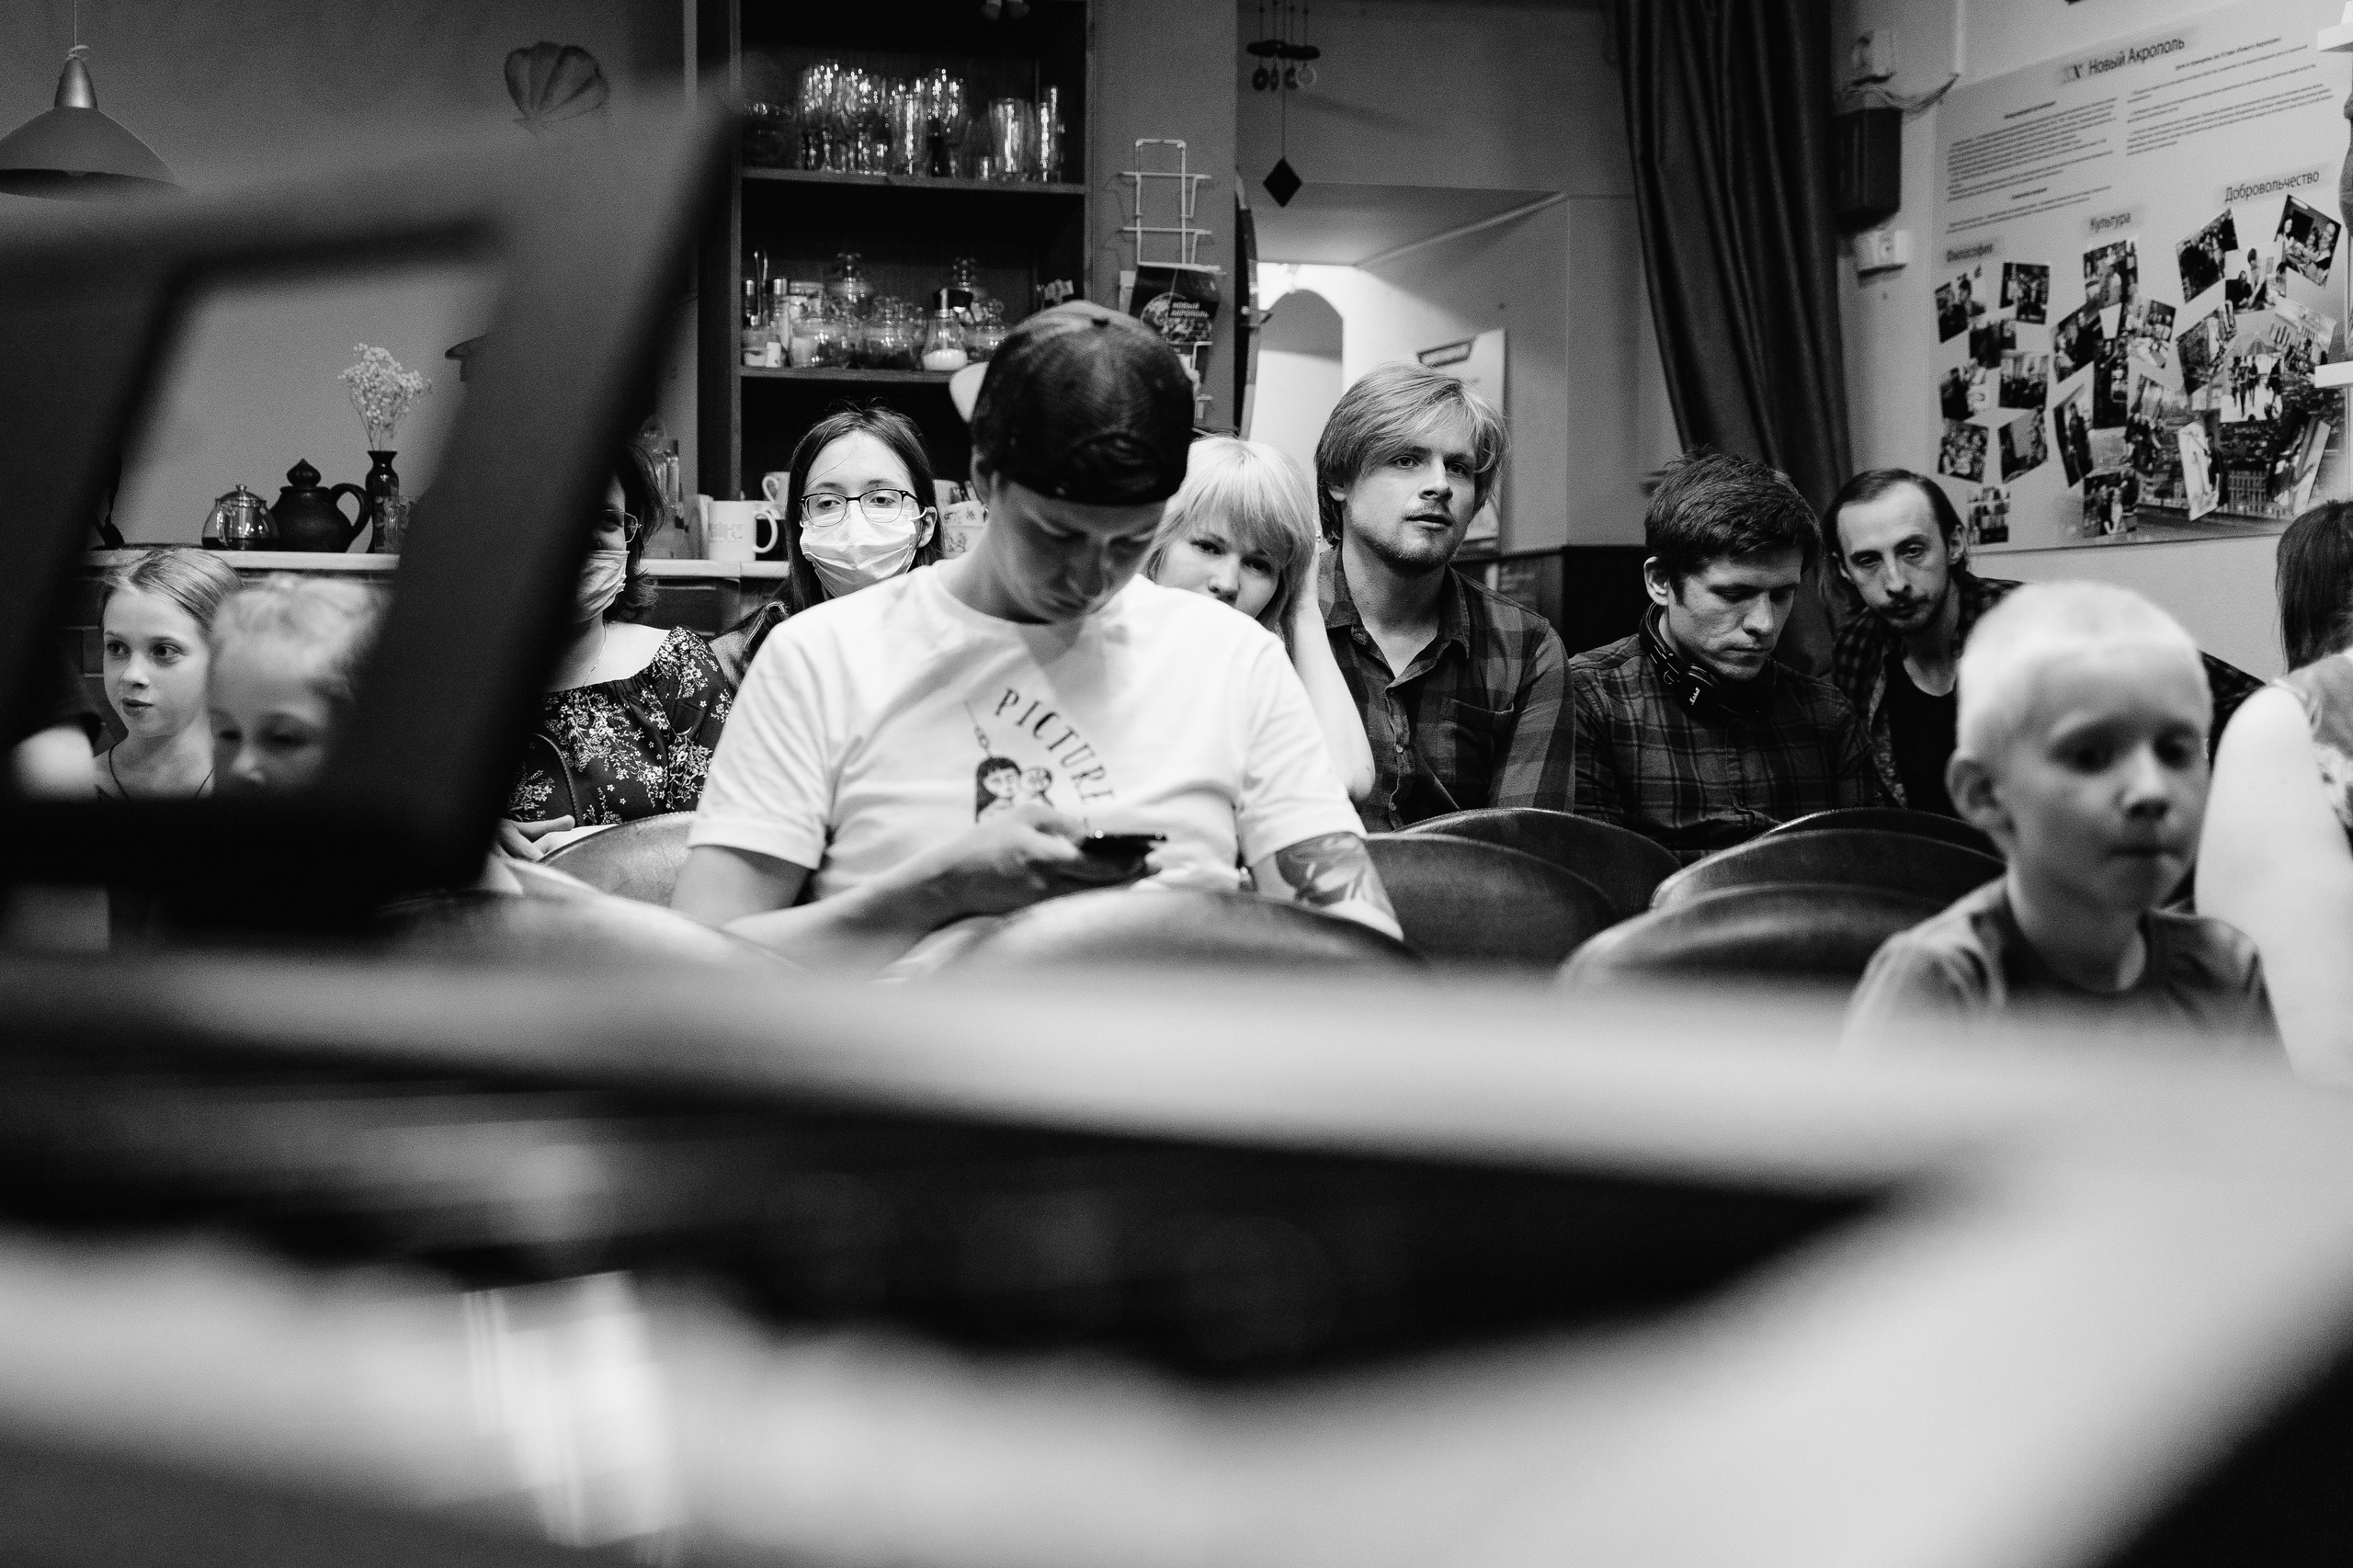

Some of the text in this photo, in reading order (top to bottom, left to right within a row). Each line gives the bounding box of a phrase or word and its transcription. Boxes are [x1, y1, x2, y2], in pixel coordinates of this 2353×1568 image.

[2088, 50, 2125, 75] Новый
[2128, 38, 2185, 65] Акрополь
[2225, 170, 2320, 202] Добровольчество
